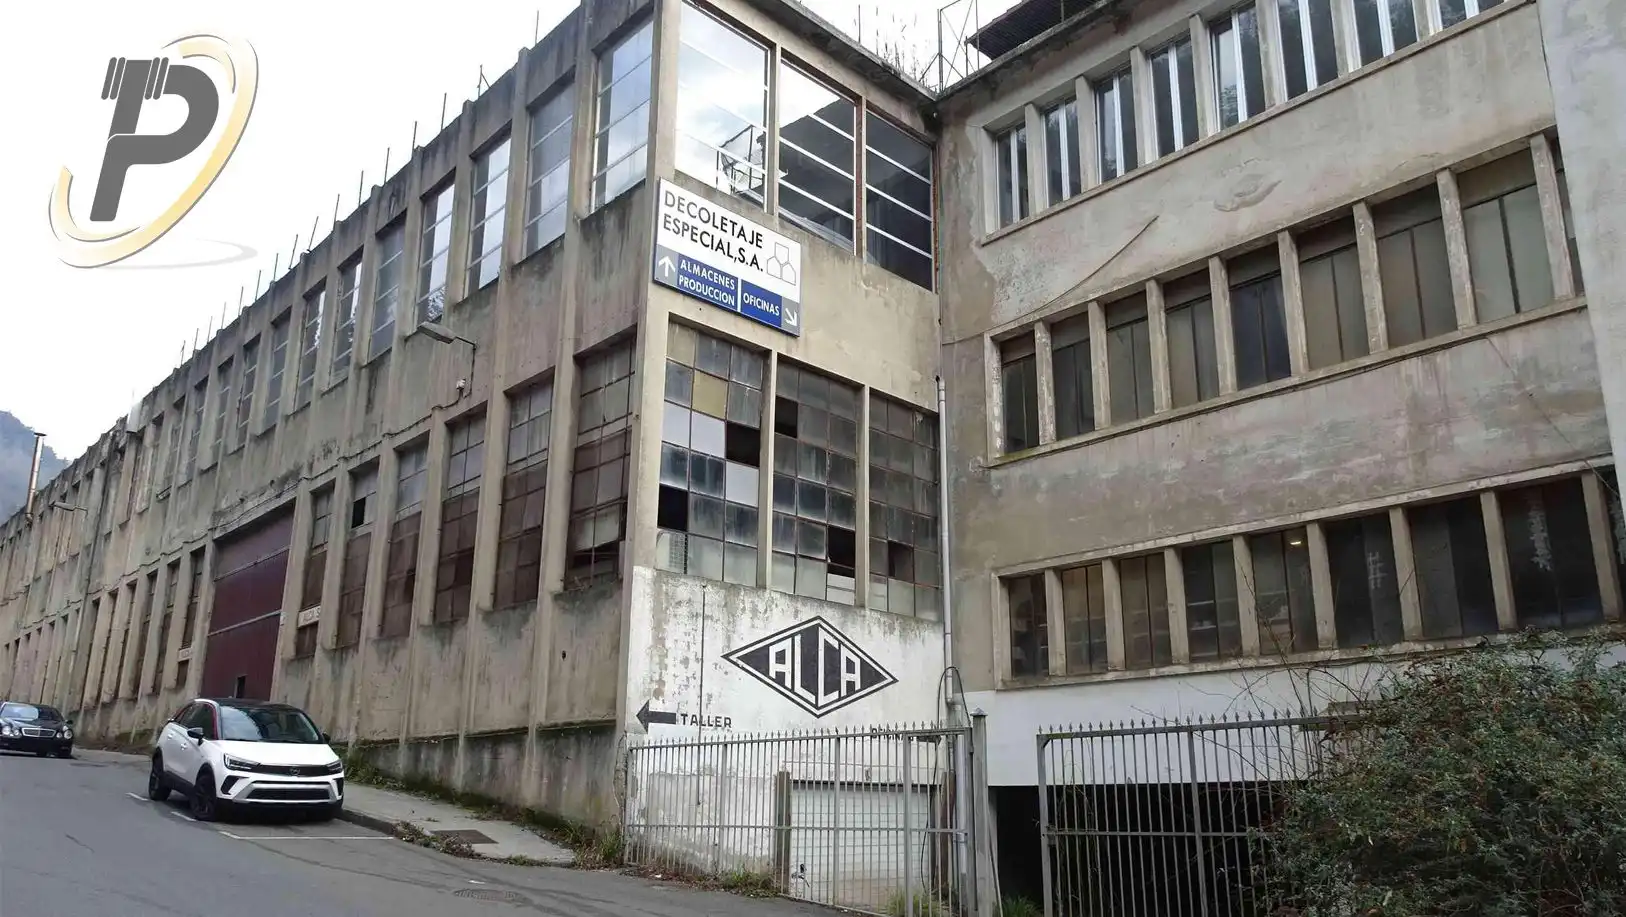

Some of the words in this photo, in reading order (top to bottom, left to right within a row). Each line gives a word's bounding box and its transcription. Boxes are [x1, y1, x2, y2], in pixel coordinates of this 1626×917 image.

[664, 190, 763, 249] DECOLETAJE
[680, 260, 735, 290] ALMACENES
[679, 276, 735, 306] PRODUCCION
[743, 293, 780, 316] OFICINAS
[768, 626, 861, 706] ALCA
[680, 713, 732, 728] TALLER
